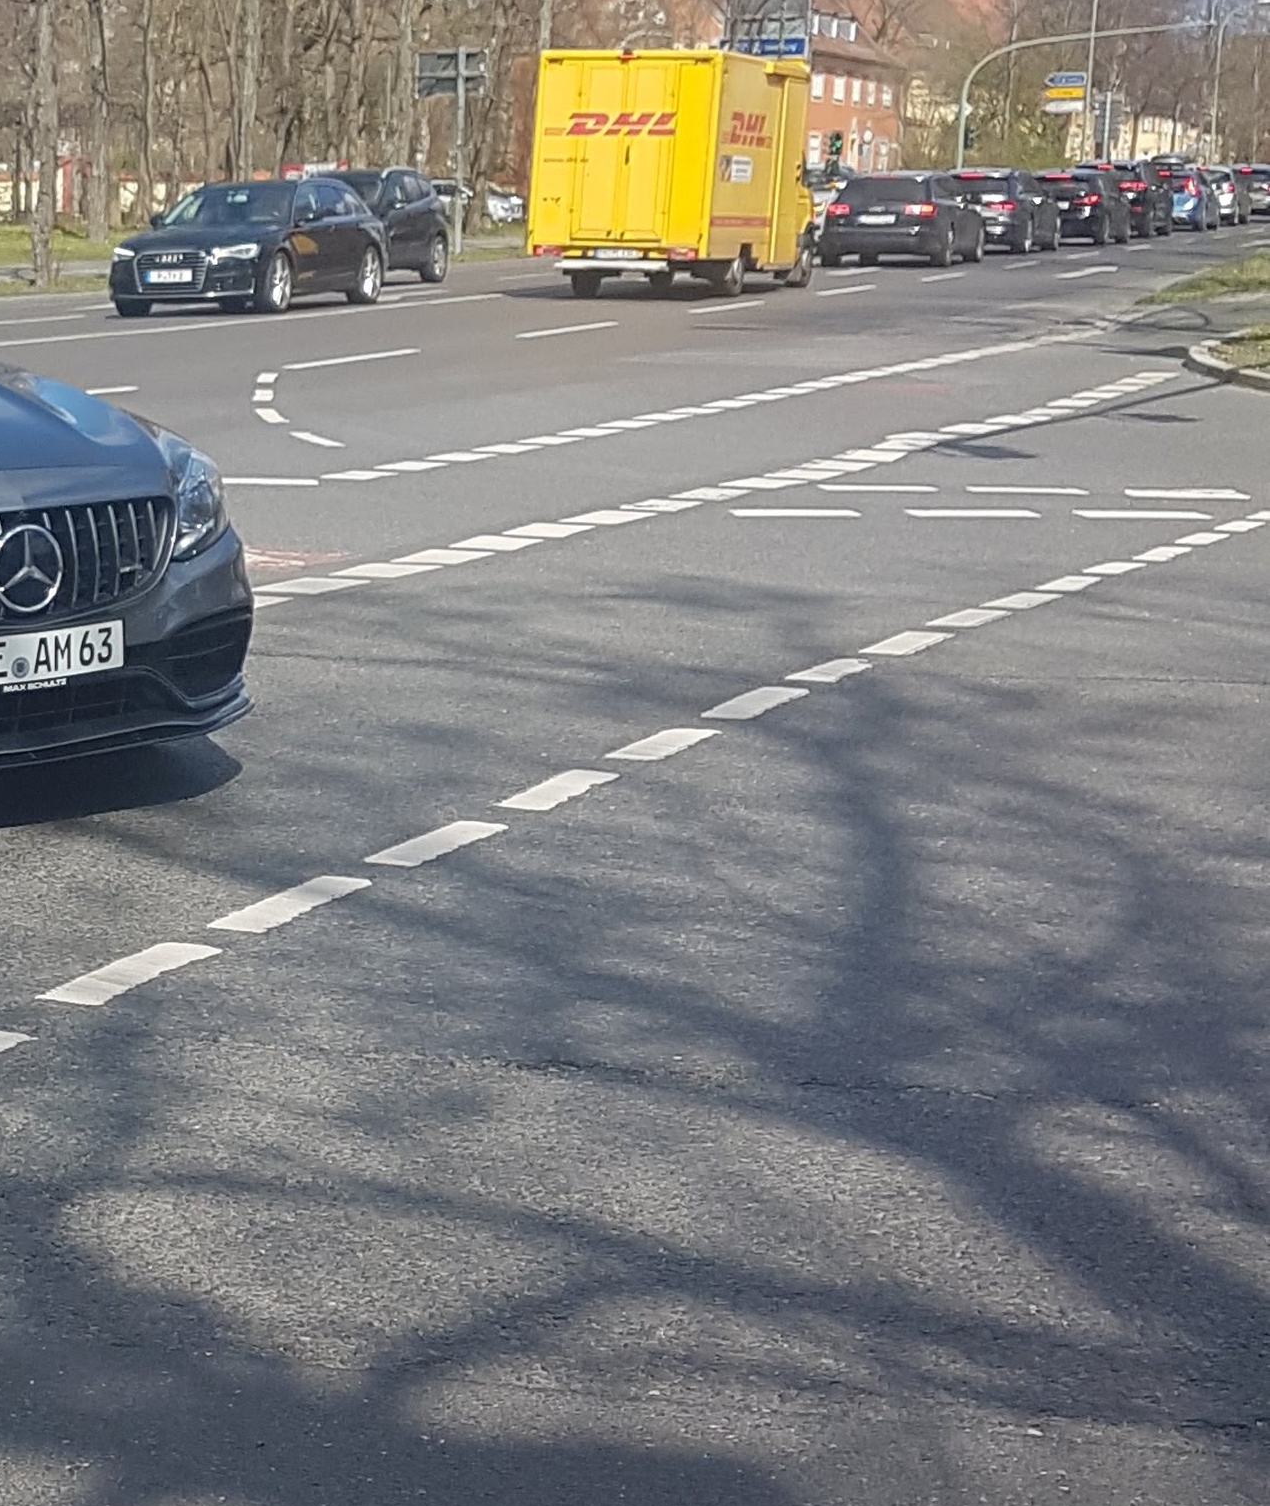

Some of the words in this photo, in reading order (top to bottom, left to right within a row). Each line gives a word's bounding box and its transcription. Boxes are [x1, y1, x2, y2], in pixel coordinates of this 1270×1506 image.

[566, 112, 678, 136] DHL
[730, 111, 767, 147] DHL
[34, 633, 72, 674] AM
[79, 627, 112, 667] 63
[3, 683, 26, 693] MAX
